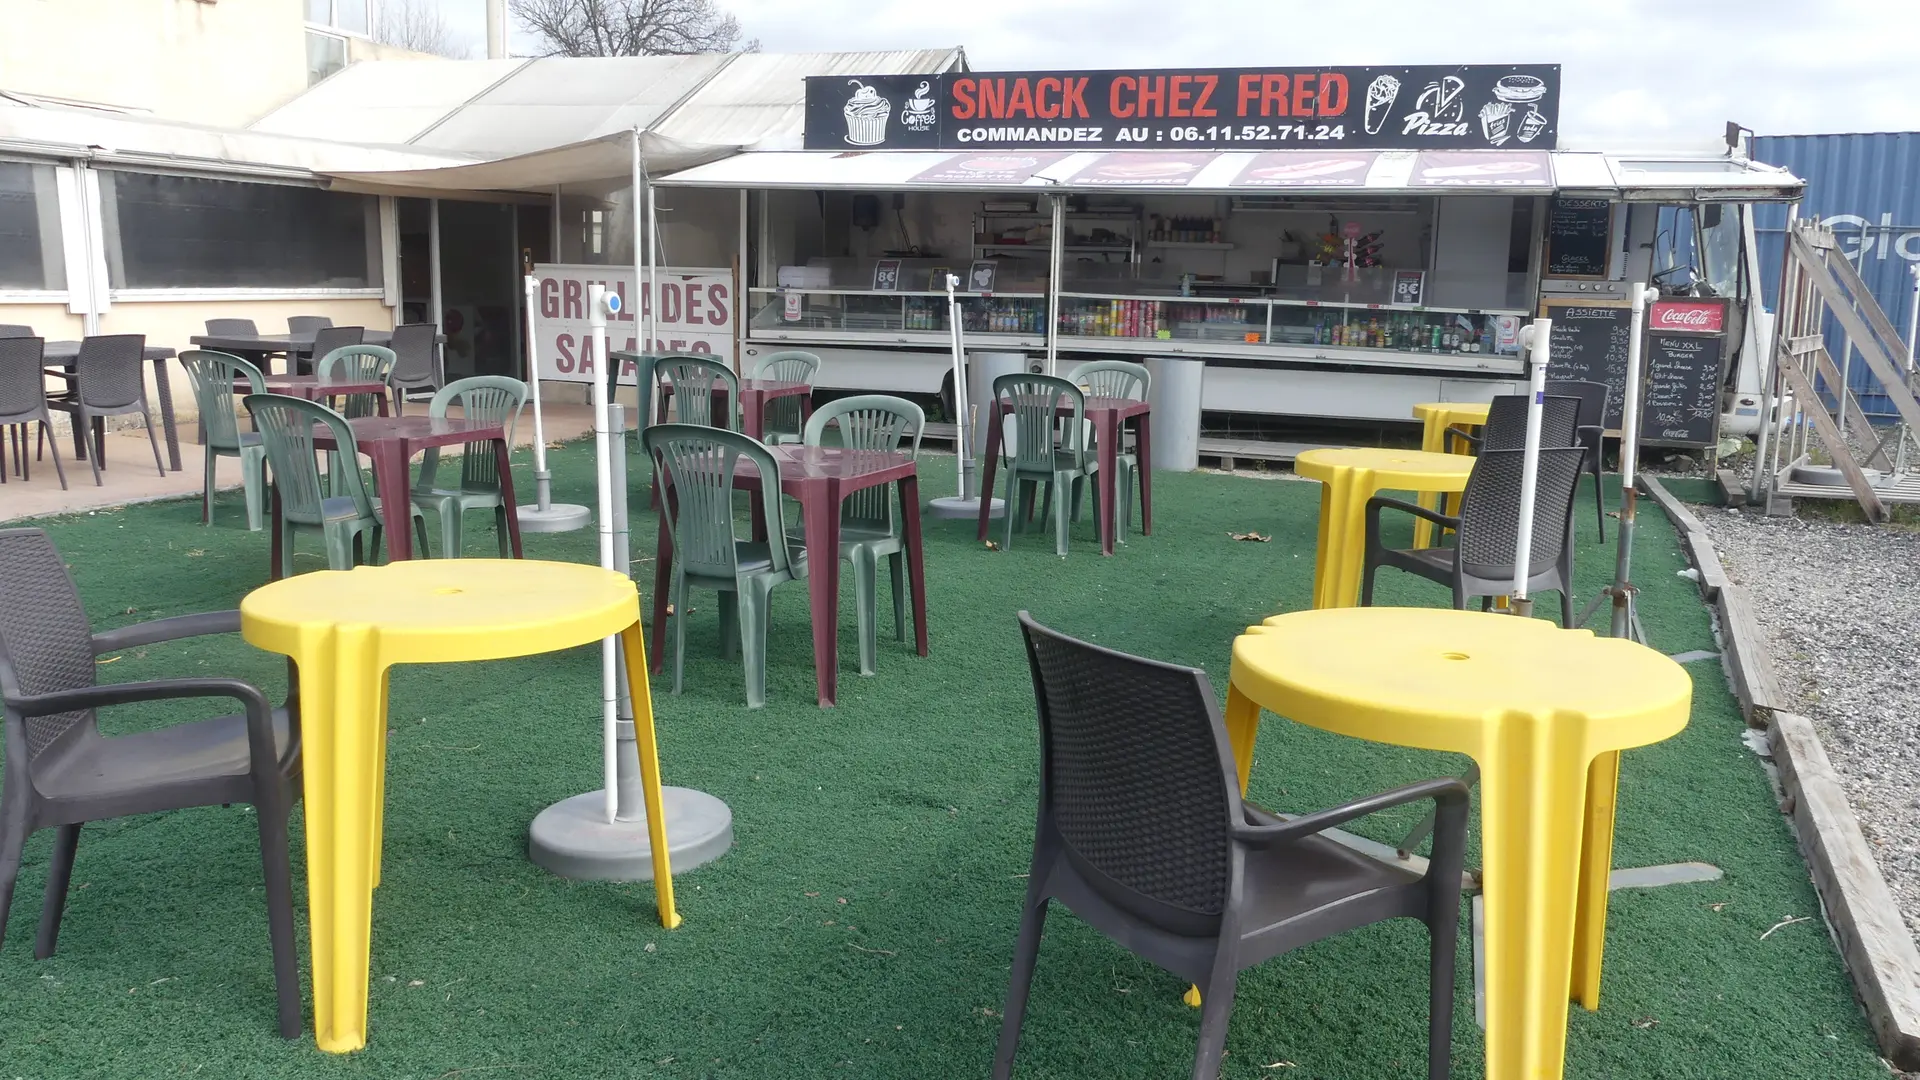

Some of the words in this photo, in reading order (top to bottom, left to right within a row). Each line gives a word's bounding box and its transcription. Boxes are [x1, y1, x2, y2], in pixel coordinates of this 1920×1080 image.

[951, 76, 1090, 119] SNACK
[1109, 74, 1220, 118] CHEZ
[1236, 72, 1350, 118] FRED
[901, 110, 936, 126] Coffee
[1402, 111, 1469, 136] Pizza
[957, 127, 1103, 142] COMMANDEZ
[1116, 127, 1149, 142] AU
[1169, 125, 1345, 142] 06.11.52.71.24
[1661, 308, 1710, 325] Coca-Cola
